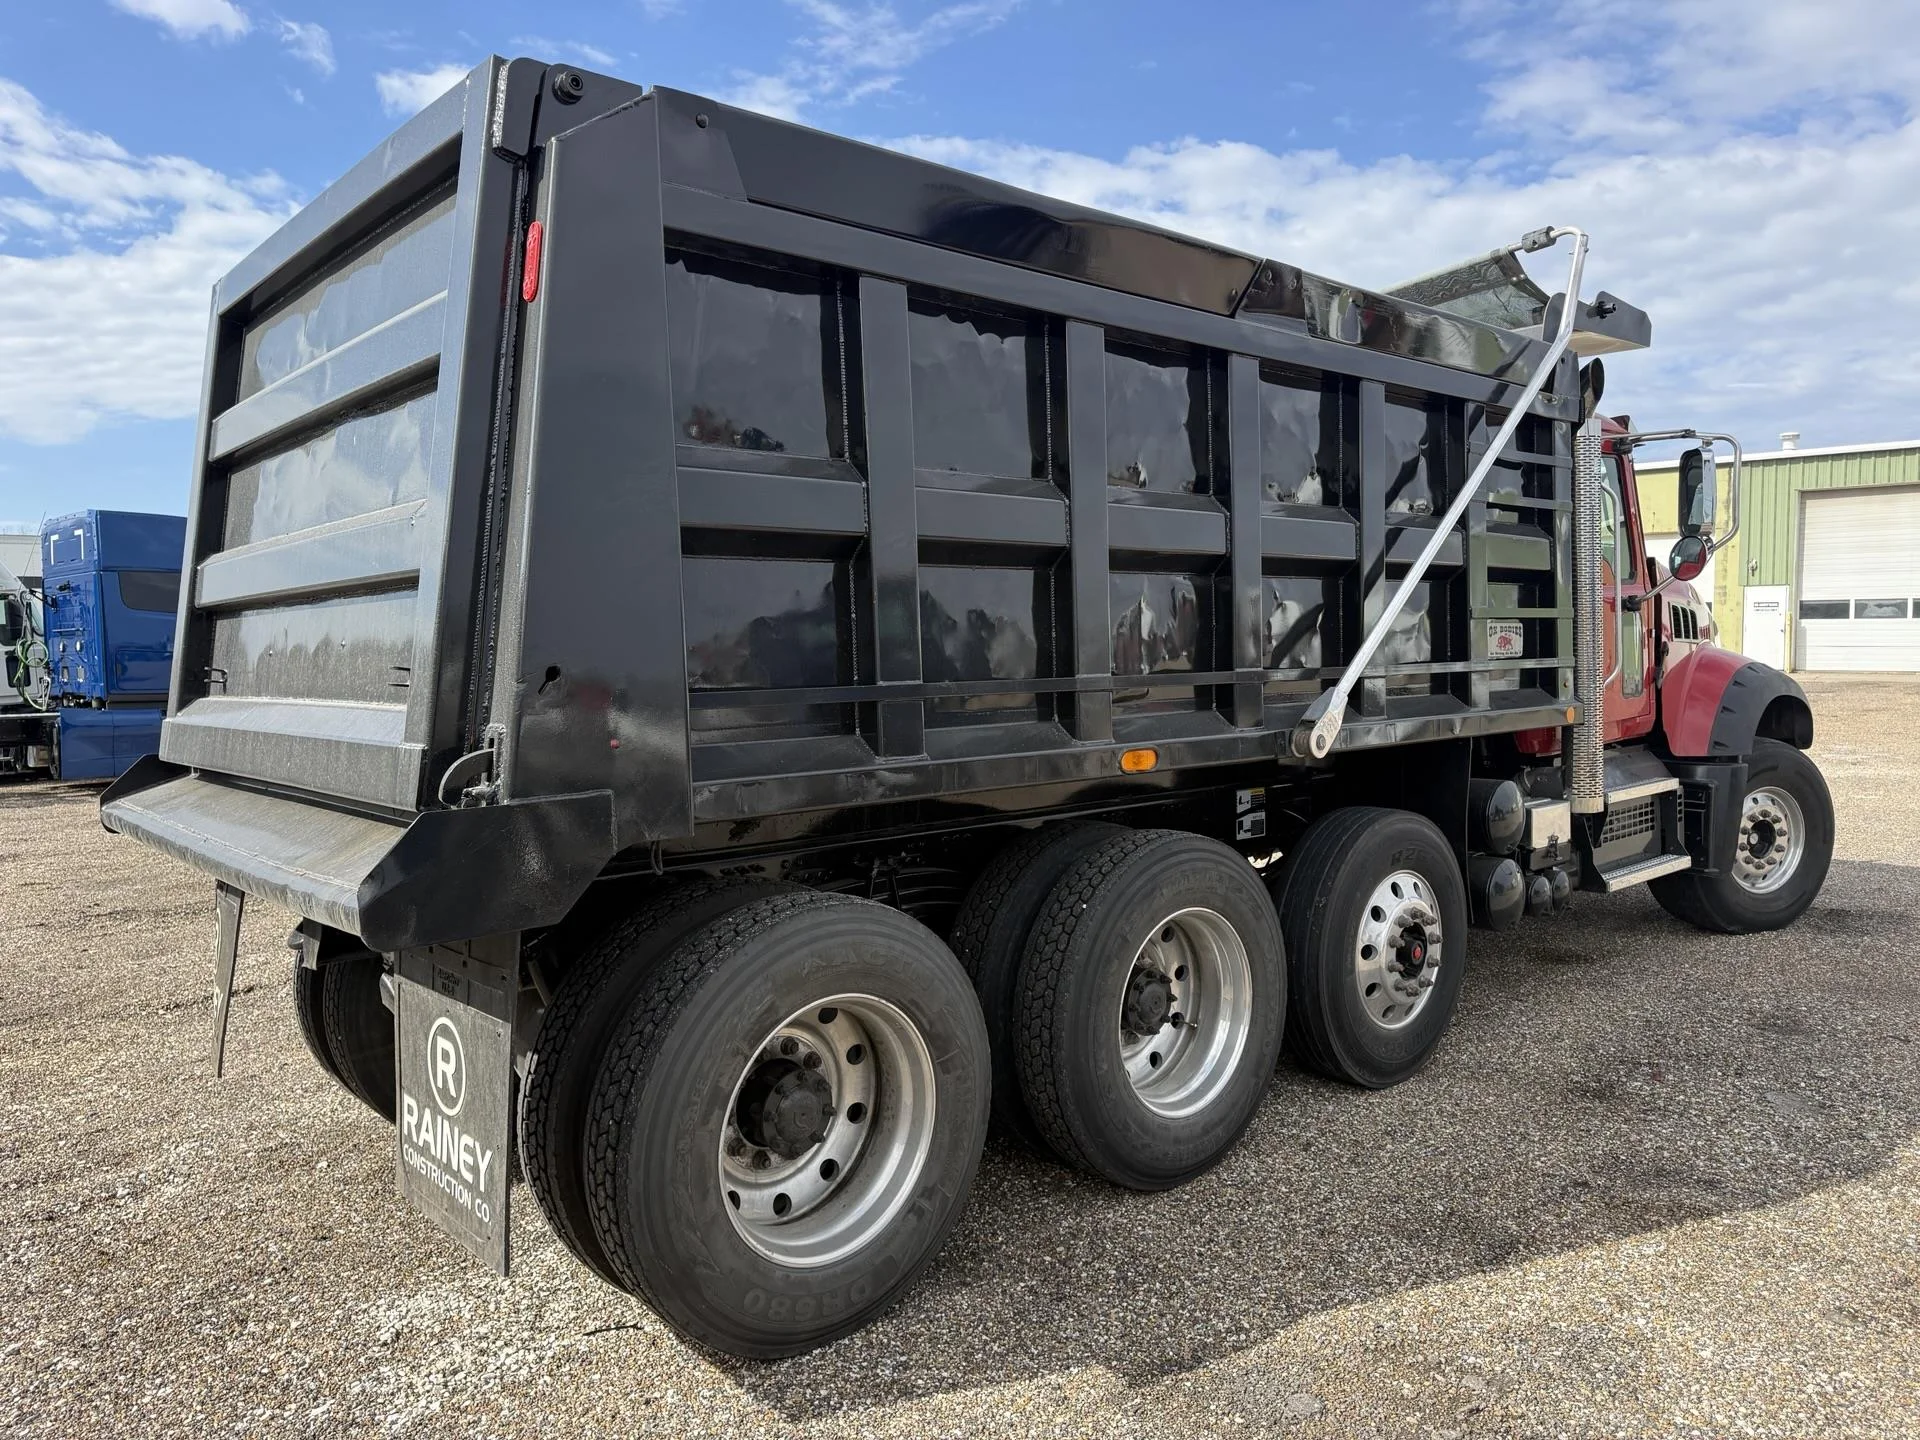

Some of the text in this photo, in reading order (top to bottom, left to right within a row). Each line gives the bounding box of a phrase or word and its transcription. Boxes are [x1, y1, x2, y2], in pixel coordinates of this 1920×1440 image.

[436, 1035, 457, 1098] R
[402, 1092, 494, 1193] RAINEY
[403, 1143, 492, 1225] CONSTRUCTION CO.
